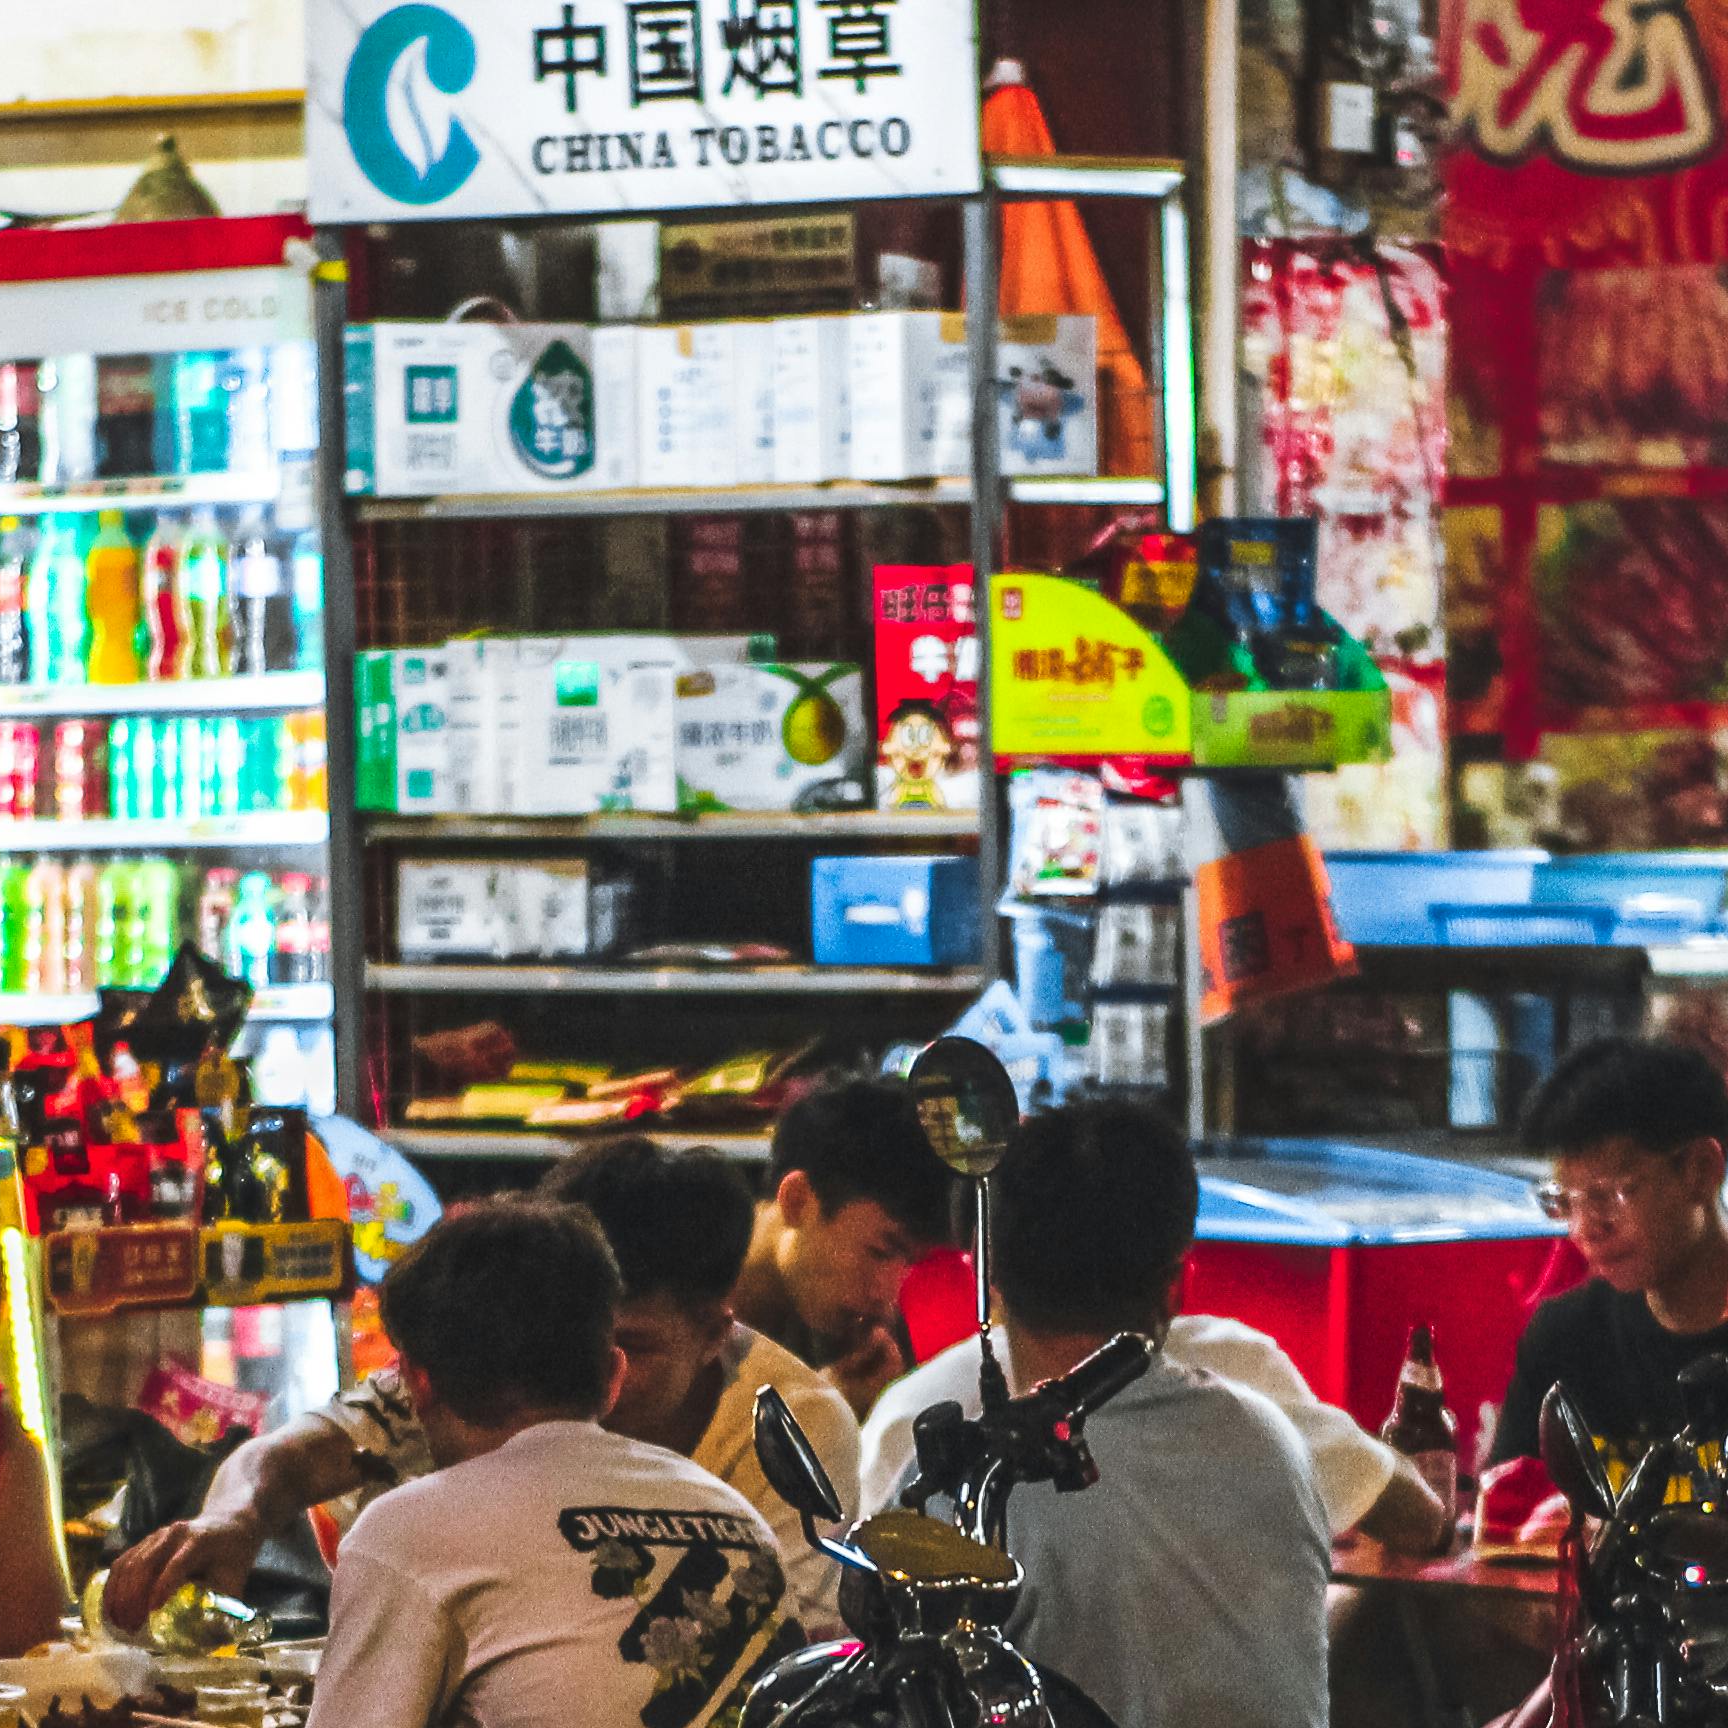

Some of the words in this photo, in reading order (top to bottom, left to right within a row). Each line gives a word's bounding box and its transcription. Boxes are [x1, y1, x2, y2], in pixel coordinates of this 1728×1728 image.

[532, 0, 905, 113] 中国烟草
[531, 129, 678, 176] CHINA
[690, 116, 912, 168] TOBACCO
